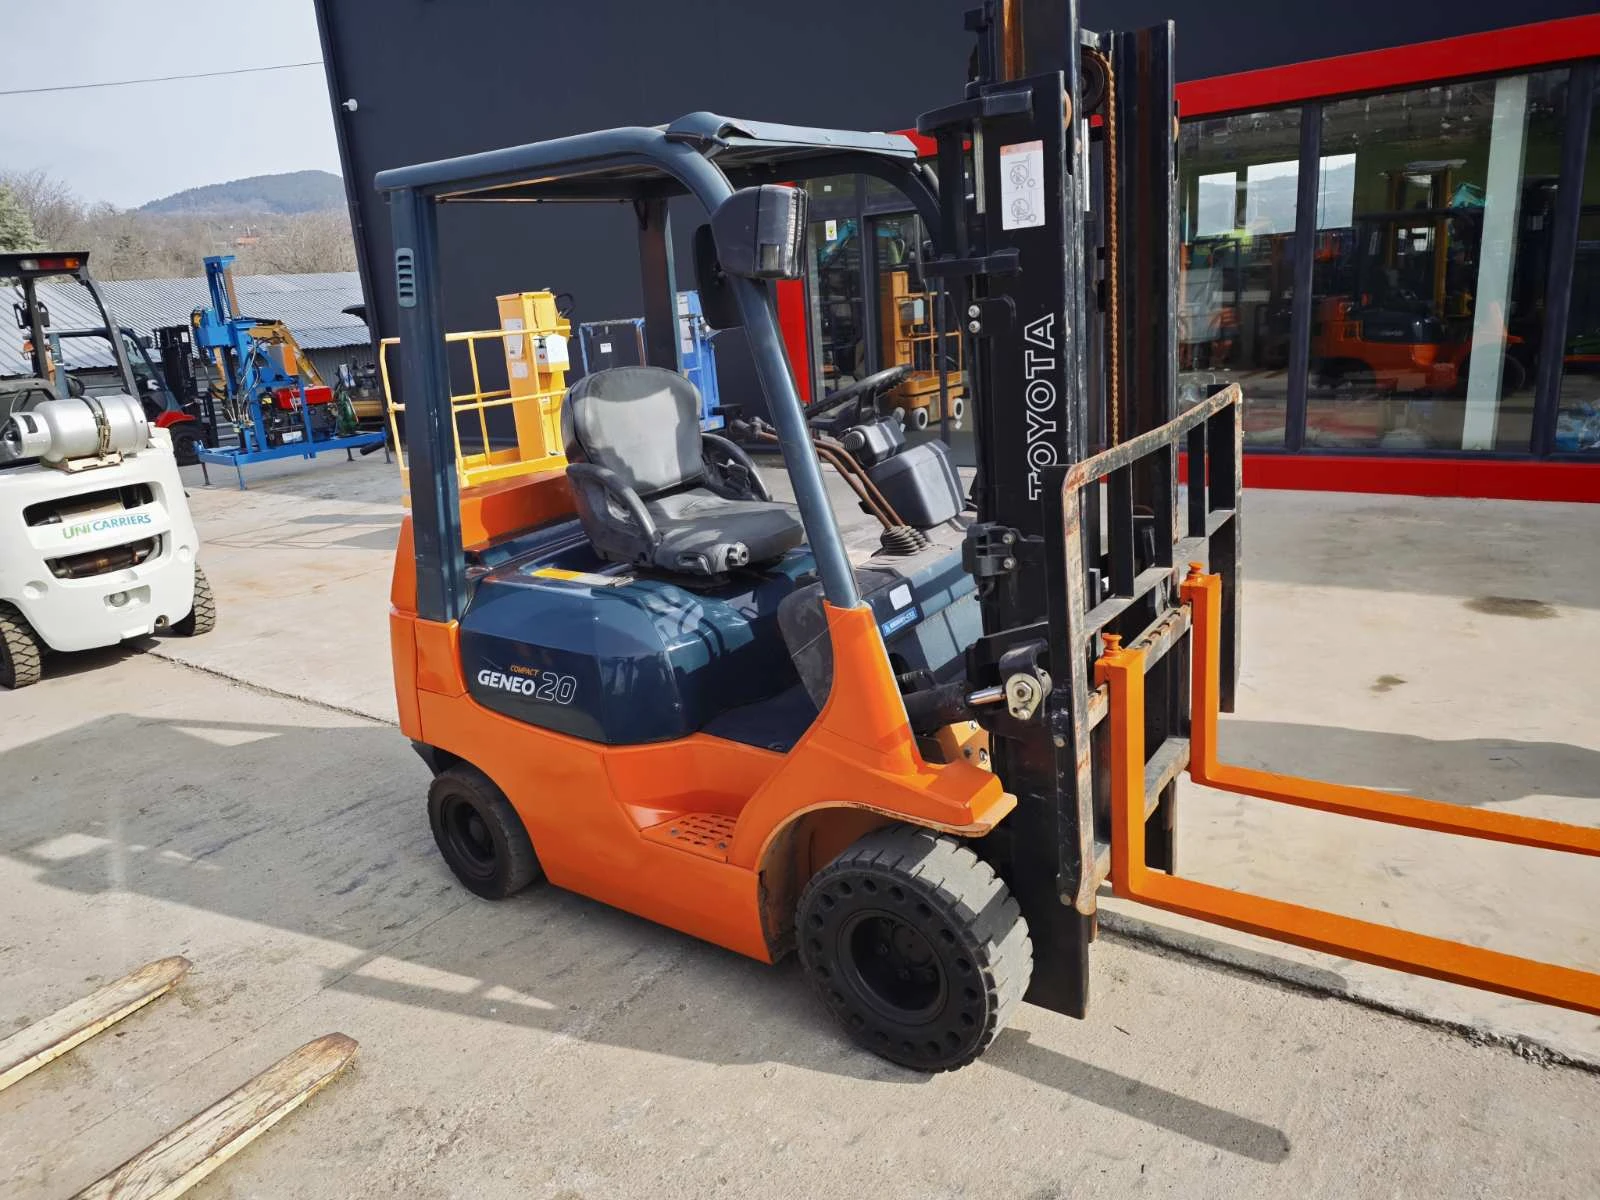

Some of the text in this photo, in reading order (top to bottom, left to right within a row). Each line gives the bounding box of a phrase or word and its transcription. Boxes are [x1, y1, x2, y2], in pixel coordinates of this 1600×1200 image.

[1024, 312, 1058, 501] TOYOTA
[477, 669, 578, 705] GENEO 20
[510, 664, 539, 677] COMPACT
